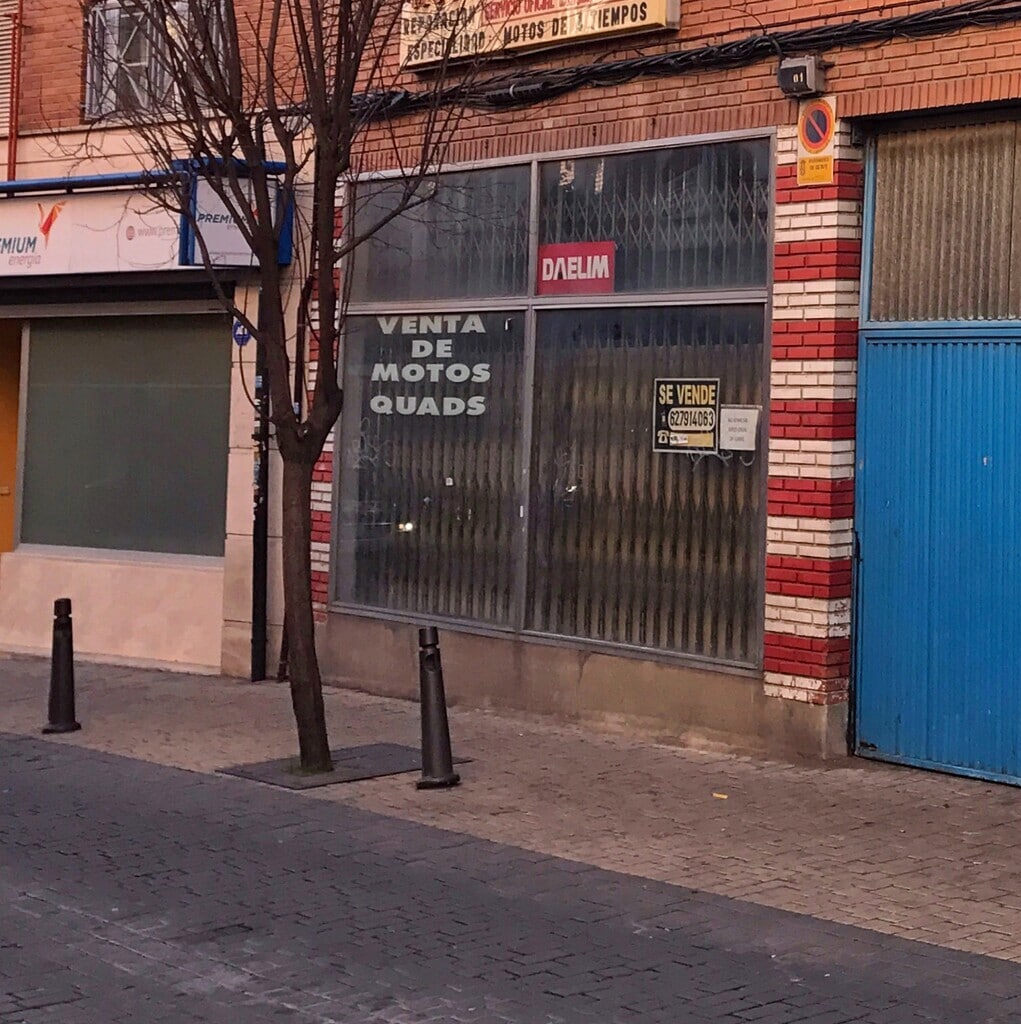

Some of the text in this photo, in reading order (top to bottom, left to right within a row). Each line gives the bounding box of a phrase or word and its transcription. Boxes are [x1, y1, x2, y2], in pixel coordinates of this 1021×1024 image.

[503, 20, 545, 44] MOTOS
[552, 15, 568, 36] DE
[541, 254, 610, 281] DAELIM
[376, 314, 486, 335] VENTA
[411, 339, 453, 359] DE
[371, 363, 491, 384] MOTOS
[369, 395, 487, 416] QUADS
[658, 384, 716, 406] SE VENDE
[669, 410, 714, 427] 627914063
